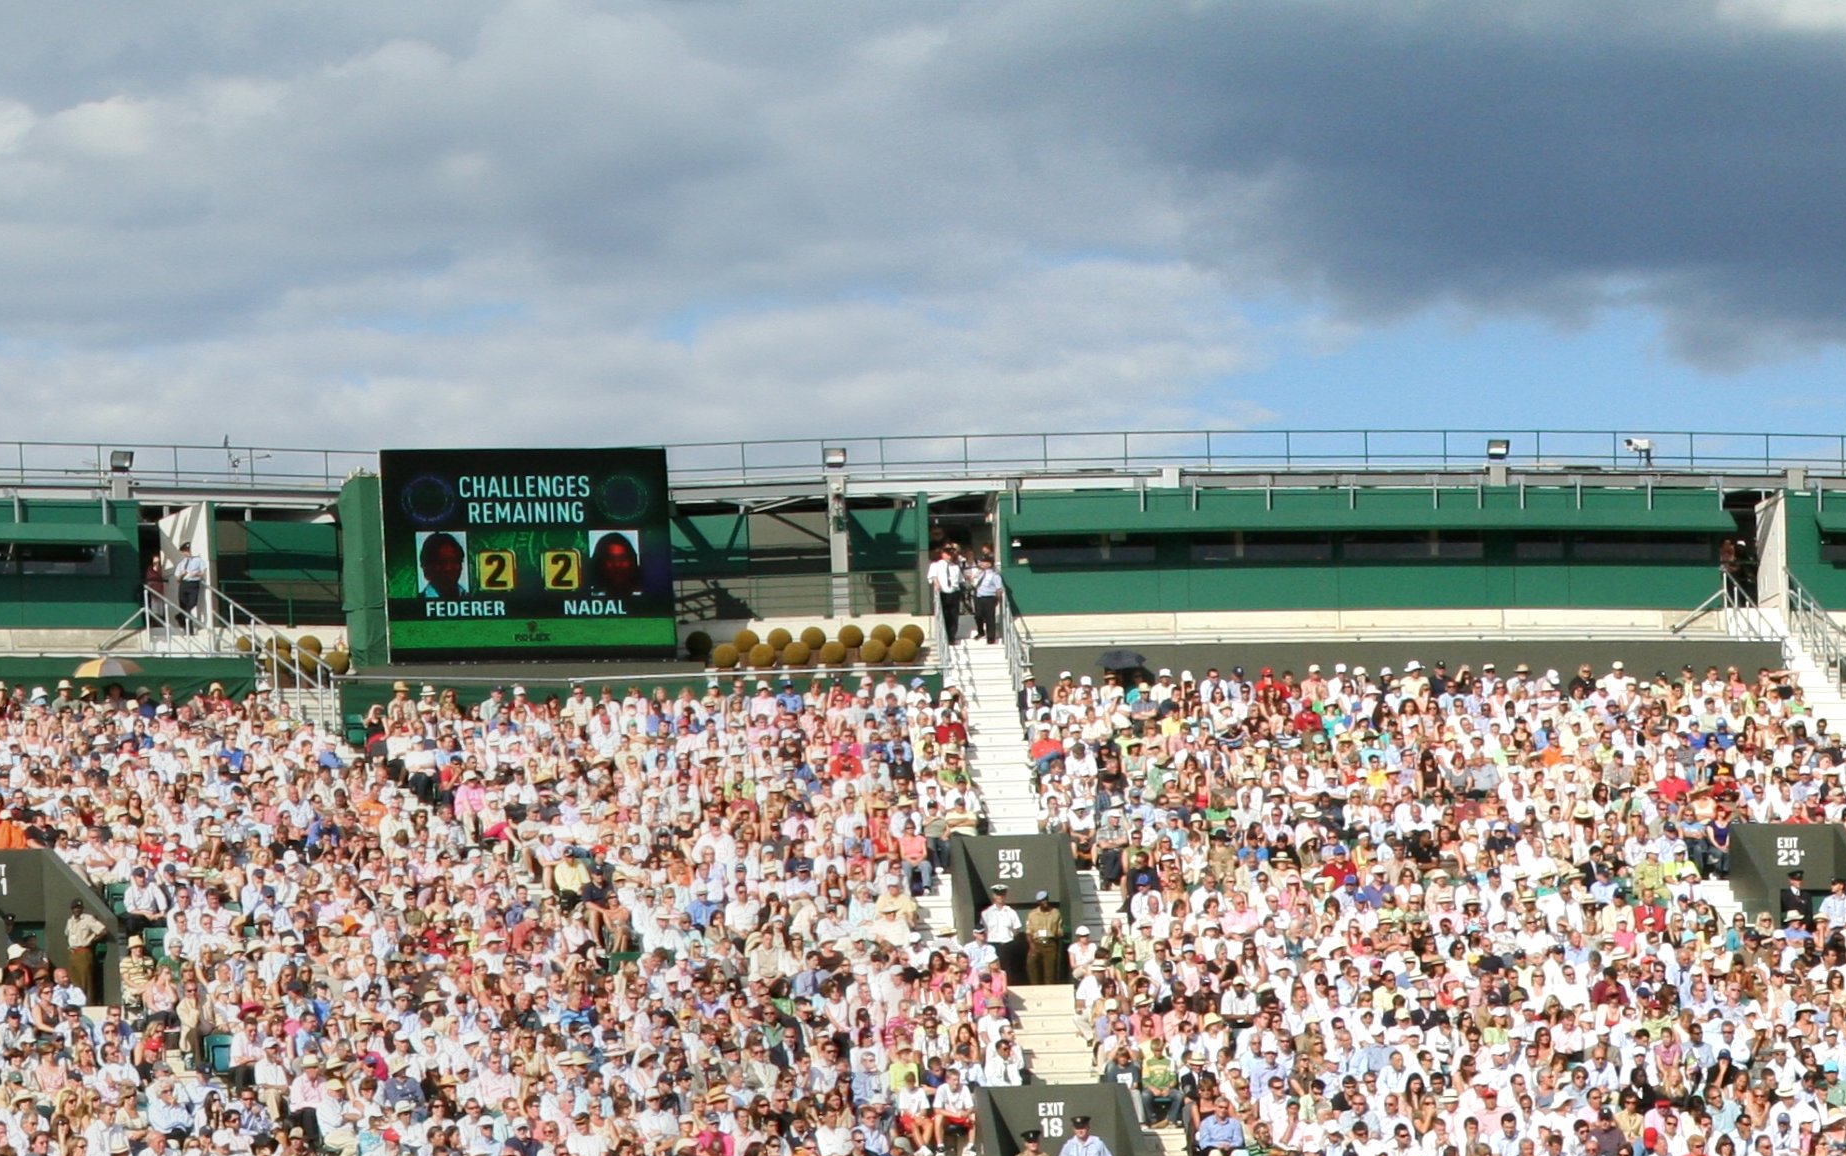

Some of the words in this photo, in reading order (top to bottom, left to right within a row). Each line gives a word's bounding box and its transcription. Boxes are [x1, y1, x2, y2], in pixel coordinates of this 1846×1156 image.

[459, 475, 590, 498] CHALLENGES
[468, 501, 584, 523] REMAINING
[484, 554, 508, 587] 2
[550, 554, 573, 587] 2
[426, 600, 505, 616] FEDERER
[564, 600, 626, 615] NADAL
[1777, 837, 1798, 849] EXIT
[998, 849, 1021, 861] EXIT
[999, 862, 1023, 879] 23
[1038, 1101, 1065, 1116] EXIT
[1040, 1117, 1063, 1138] 18
